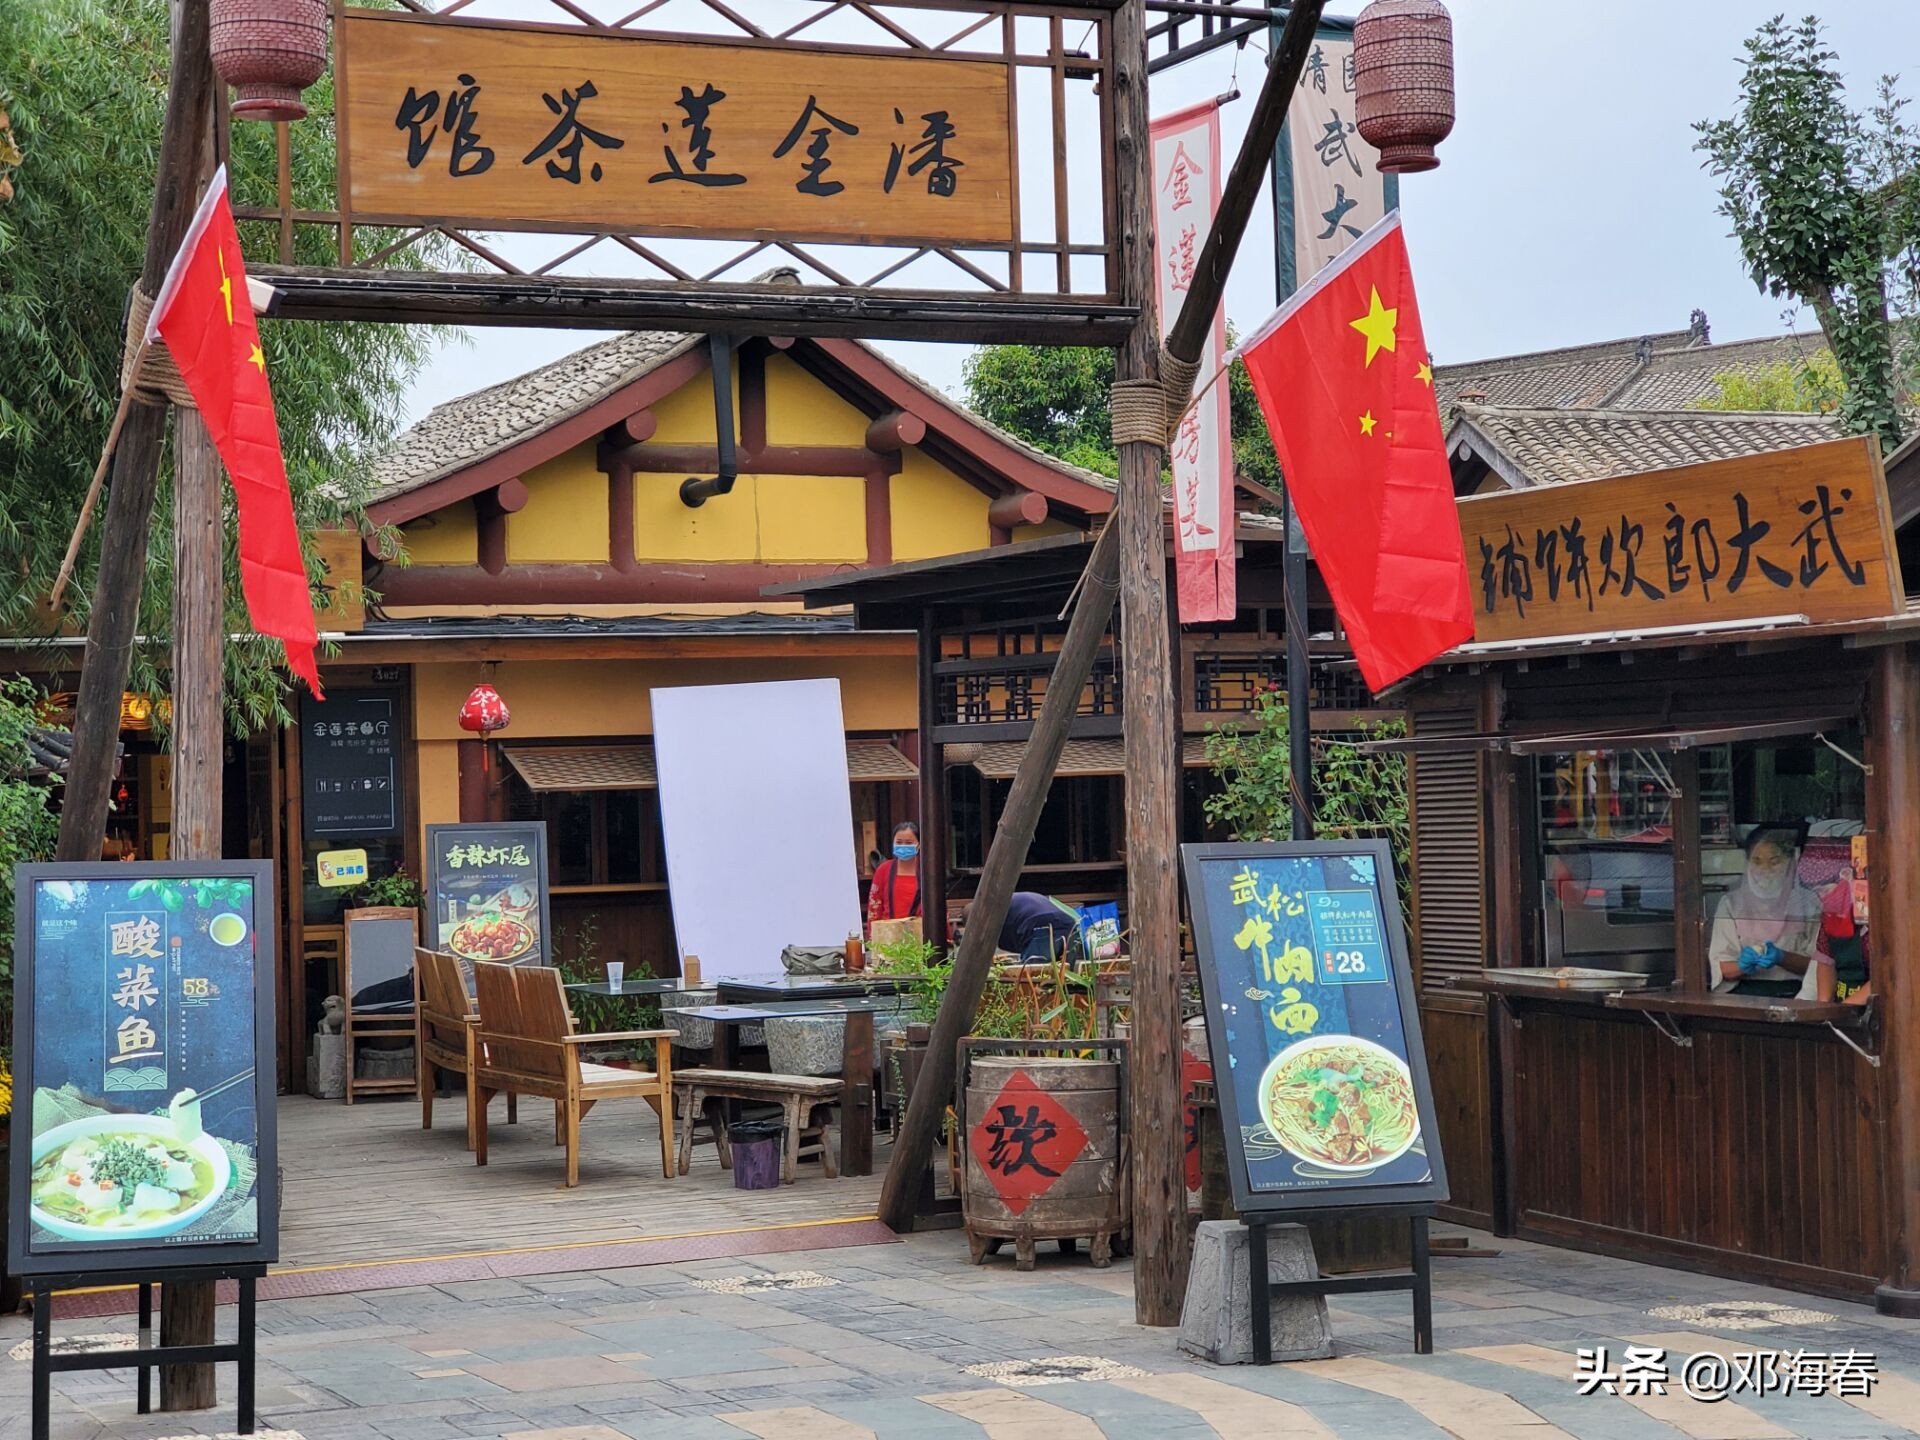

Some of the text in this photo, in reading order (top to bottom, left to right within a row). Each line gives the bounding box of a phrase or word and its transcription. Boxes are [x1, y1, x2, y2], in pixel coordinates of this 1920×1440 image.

[1314, 108, 1362, 267] 武大
[445, 844, 530, 868] 香辣虾尾
[109, 914, 165, 1064] 酸菜鱼
[1336, 951, 1366, 974] 28
